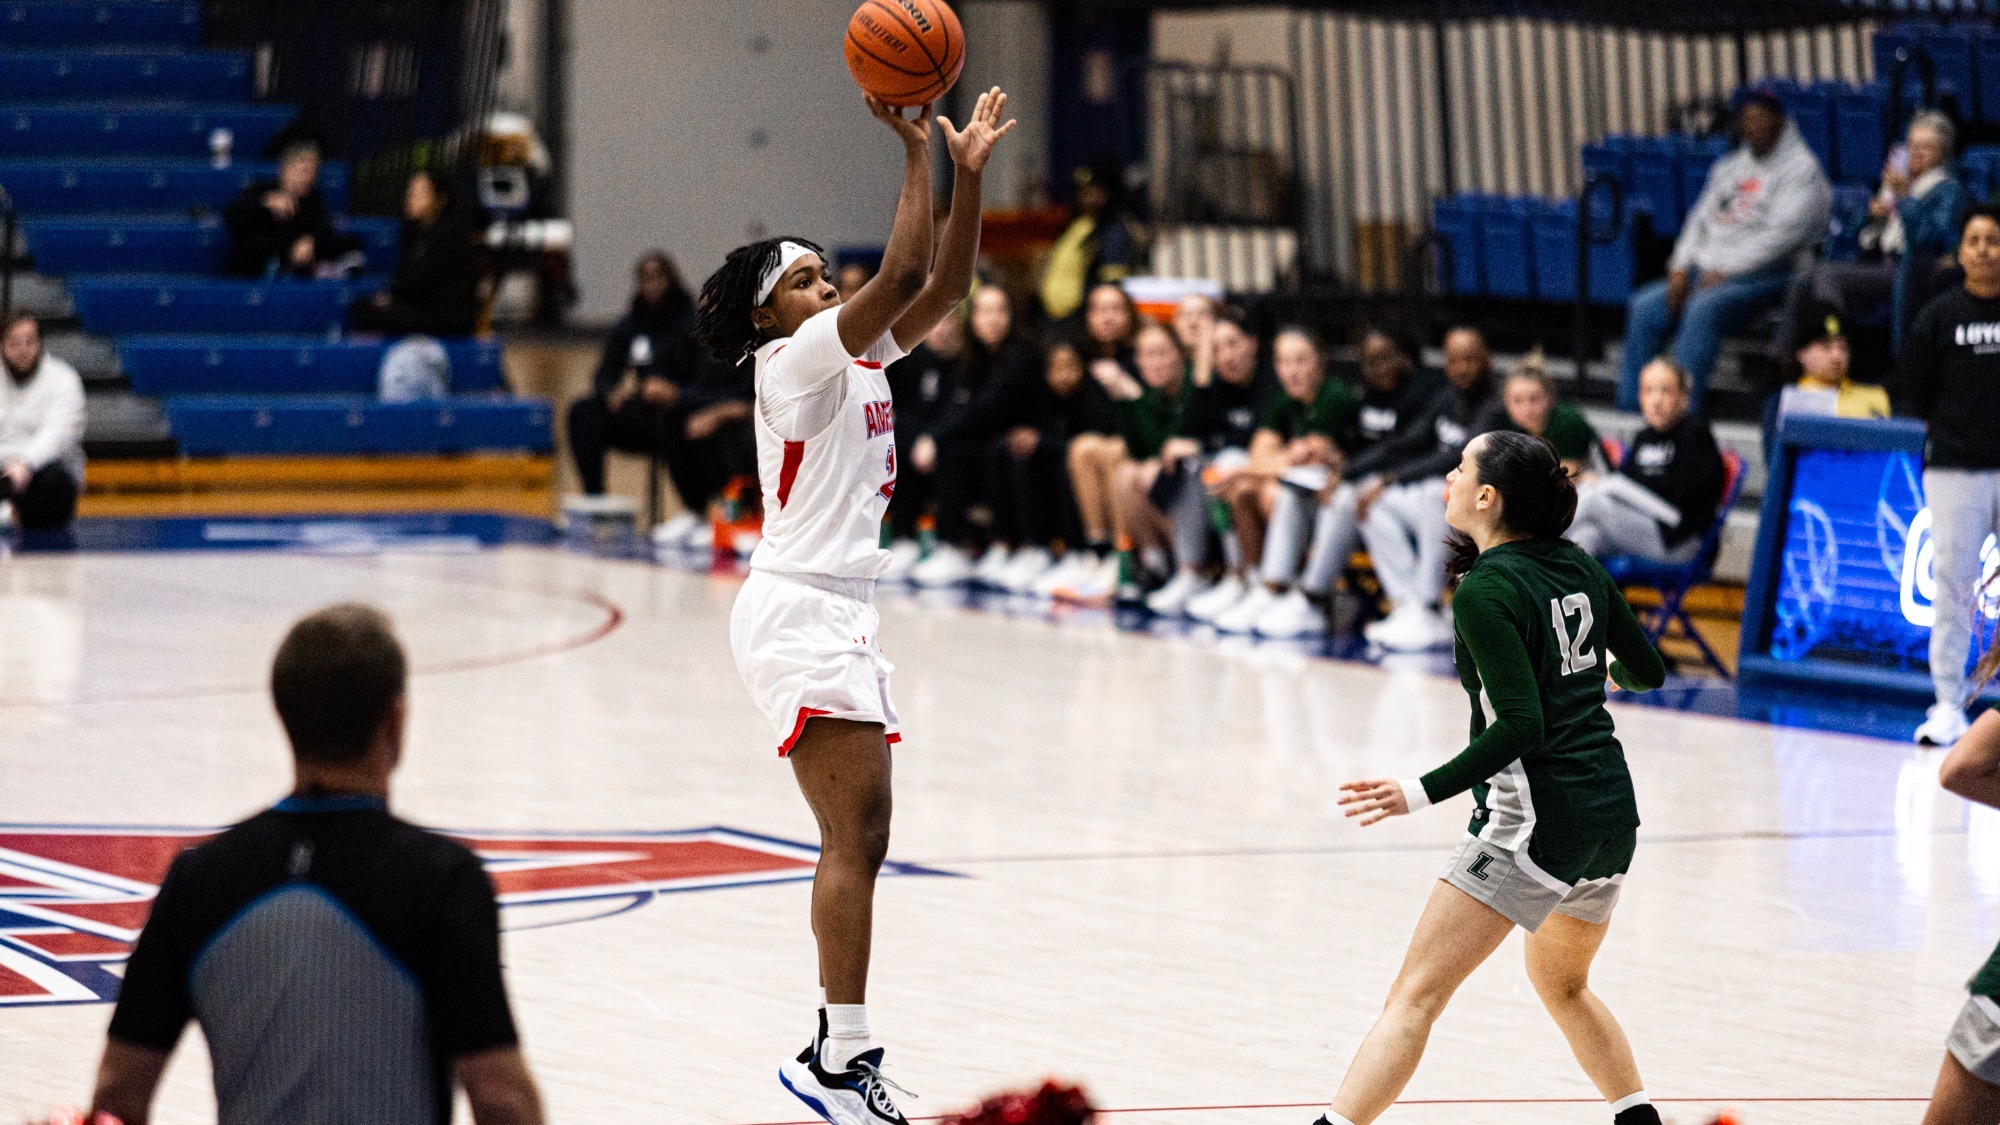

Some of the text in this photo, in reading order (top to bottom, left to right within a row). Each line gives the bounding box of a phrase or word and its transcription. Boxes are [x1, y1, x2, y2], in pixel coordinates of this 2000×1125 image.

[898, 0, 933, 34] son
[1550, 592, 1597, 676] 12
[1467, 851, 1495, 881] L
